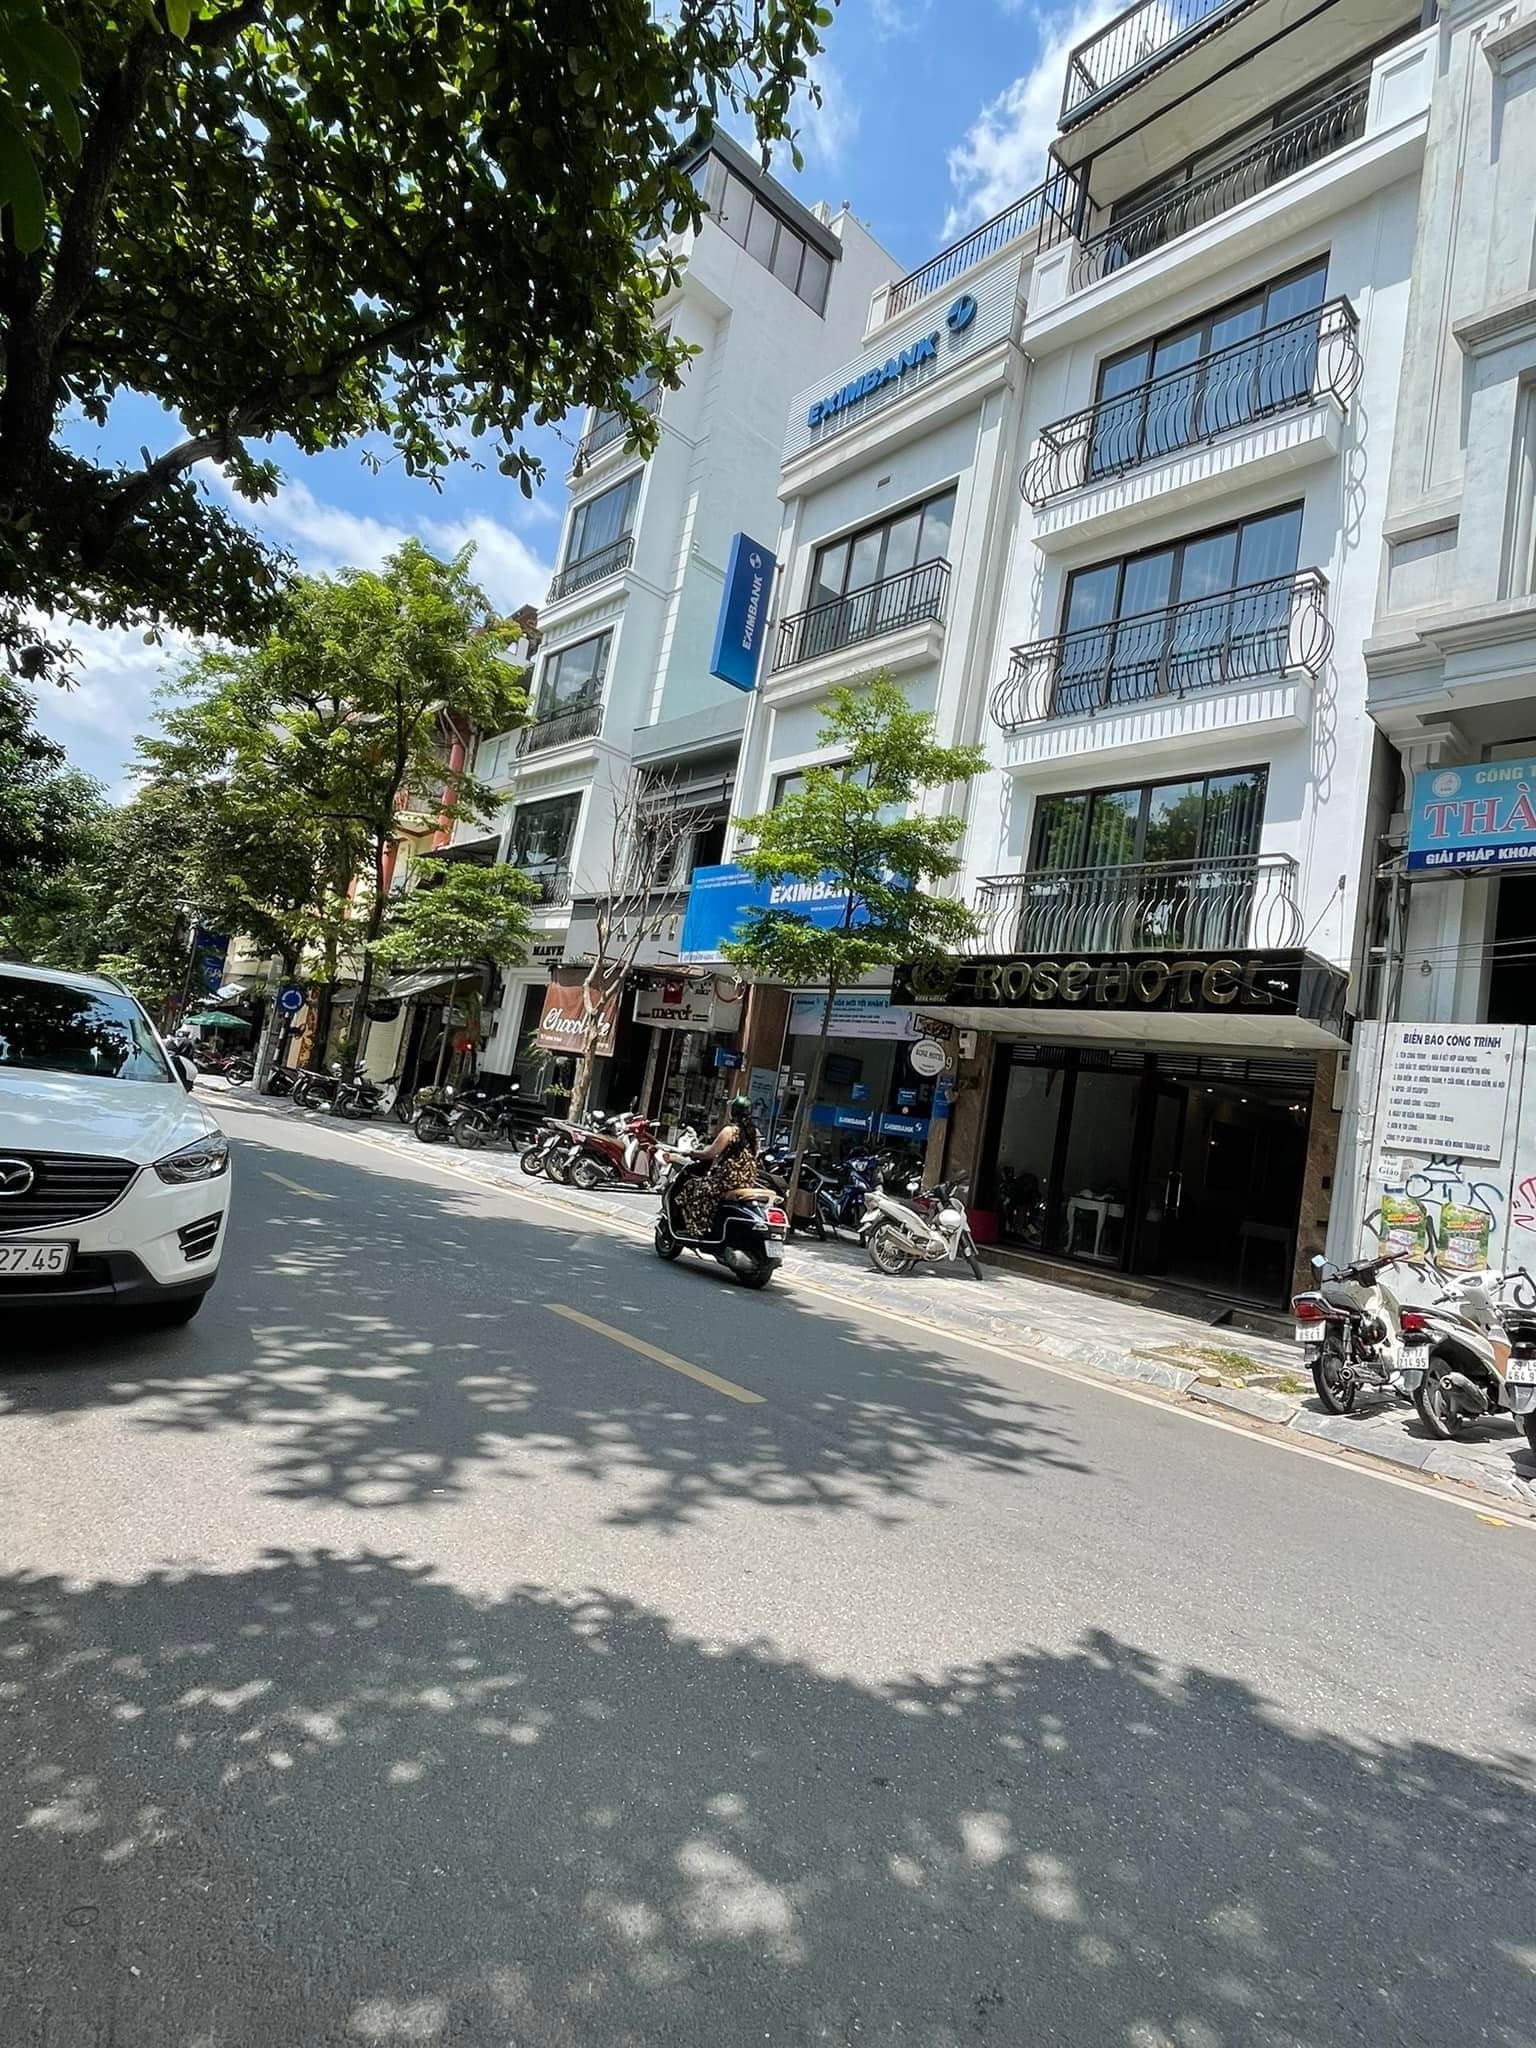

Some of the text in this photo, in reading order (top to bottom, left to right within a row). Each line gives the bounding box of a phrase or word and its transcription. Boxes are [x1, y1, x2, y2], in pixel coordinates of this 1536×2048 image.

[807, 328, 941, 428] EXIMBANK
[741, 574, 763, 650] EXIMBANK
[1425, 850, 1454, 865] GIẢI
[1456, 847, 1495, 863] PHÁP
[1095, 959, 1272, 1005] HOTEL
[542, 1006, 612, 1037] Chocolte
